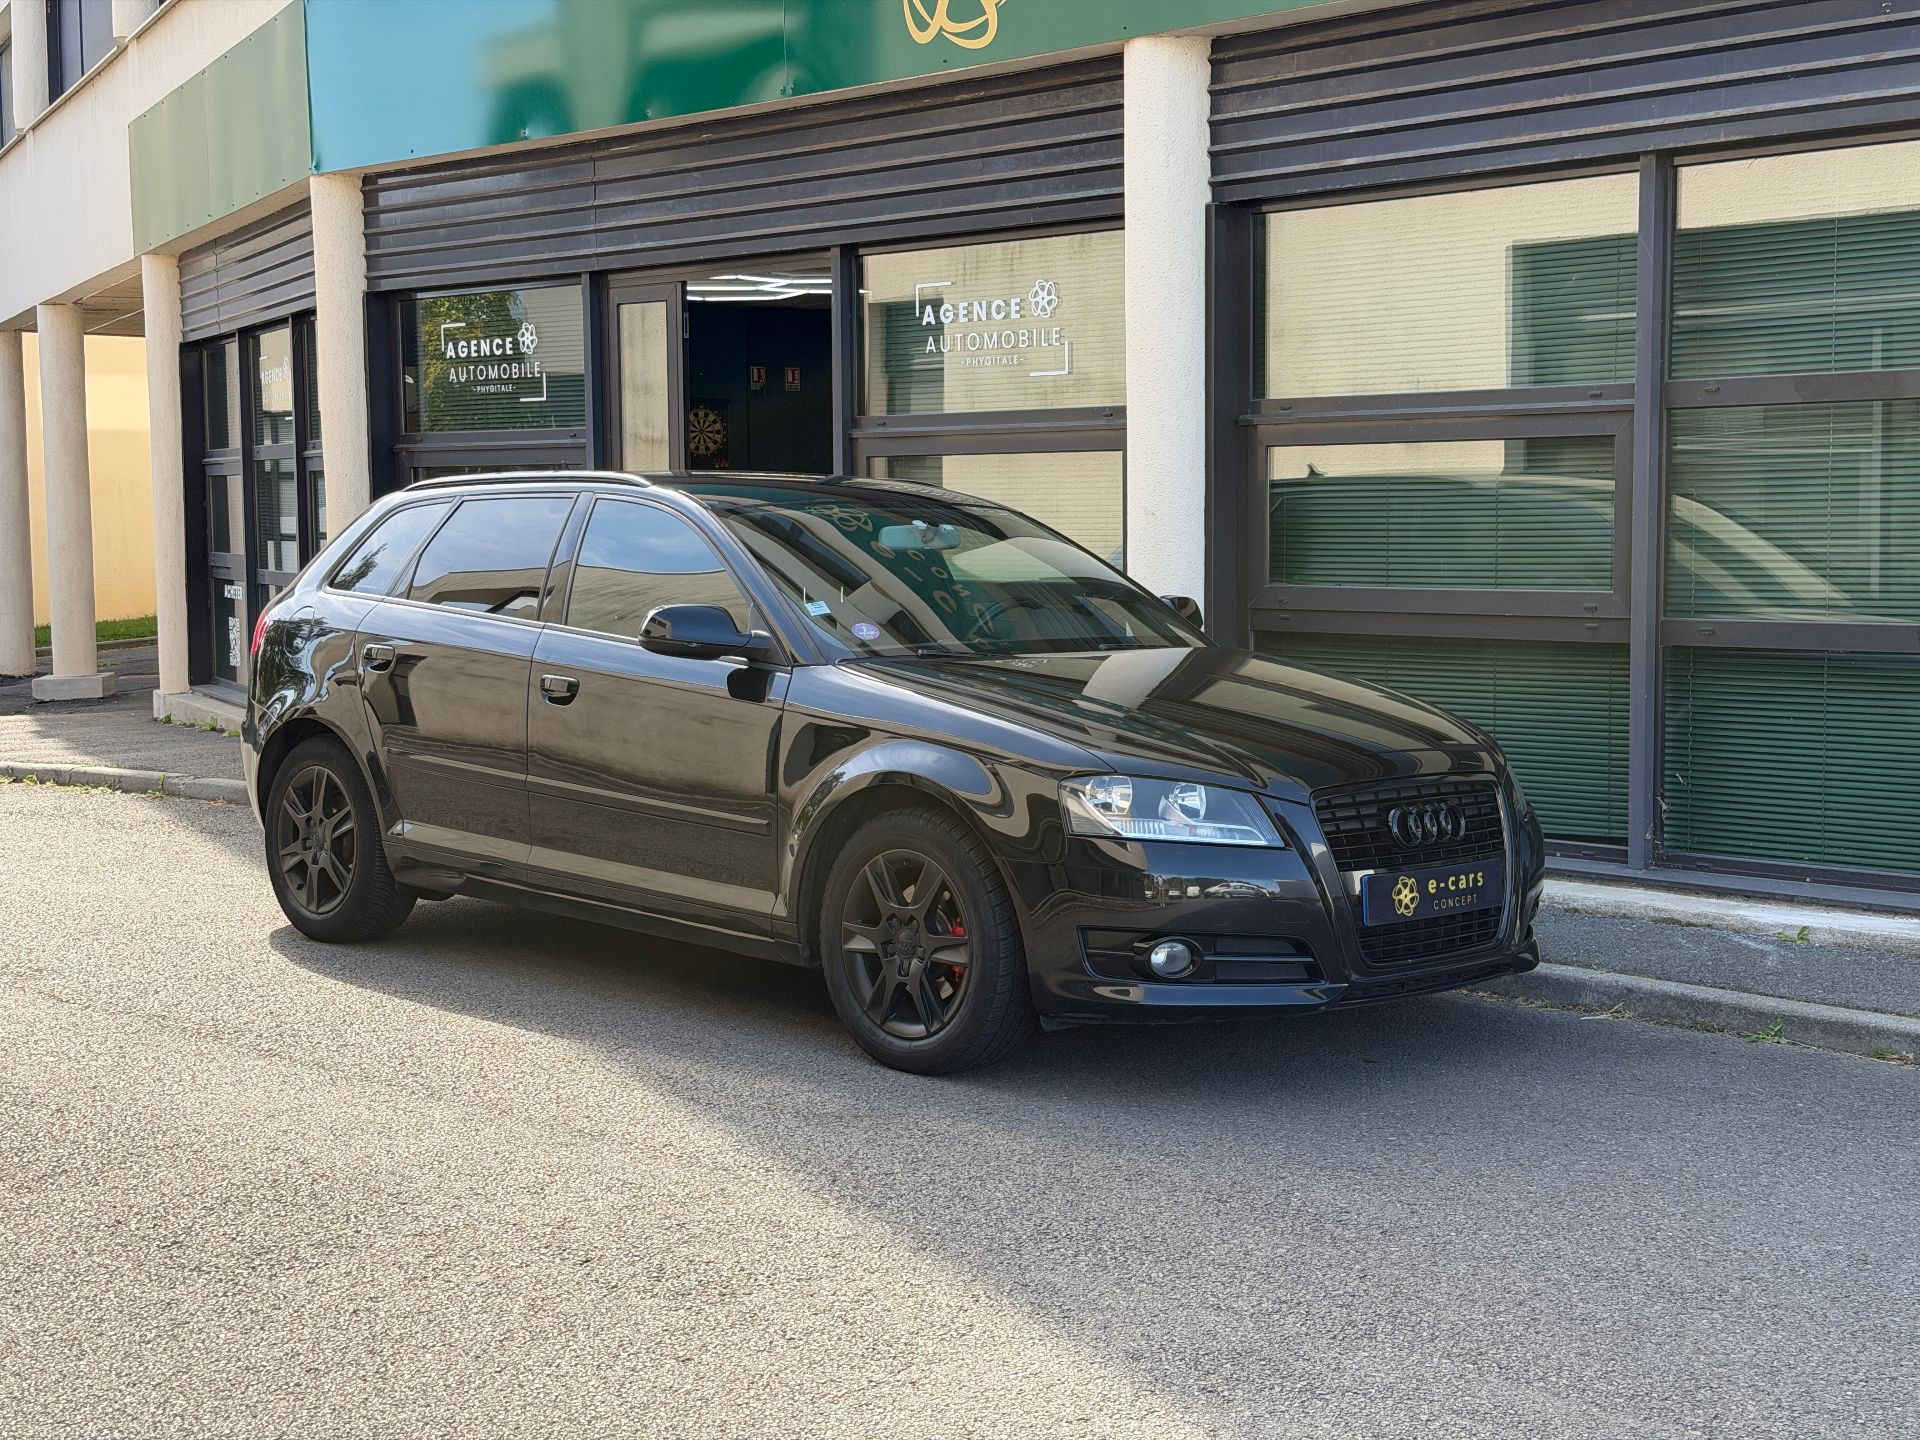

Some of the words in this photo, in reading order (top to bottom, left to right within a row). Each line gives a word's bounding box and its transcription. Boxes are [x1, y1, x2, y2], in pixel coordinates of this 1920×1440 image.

[922, 298, 1021, 326] AGENCE
[446, 337, 514, 359] AGENCE
[926, 327, 1062, 354] AUTOMOBILE
[449, 361, 541, 383] AUTOMOBILE
[1427, 871, 1484, 894] e-cars
[1433, 893, 1478, 910] CONCEPT
